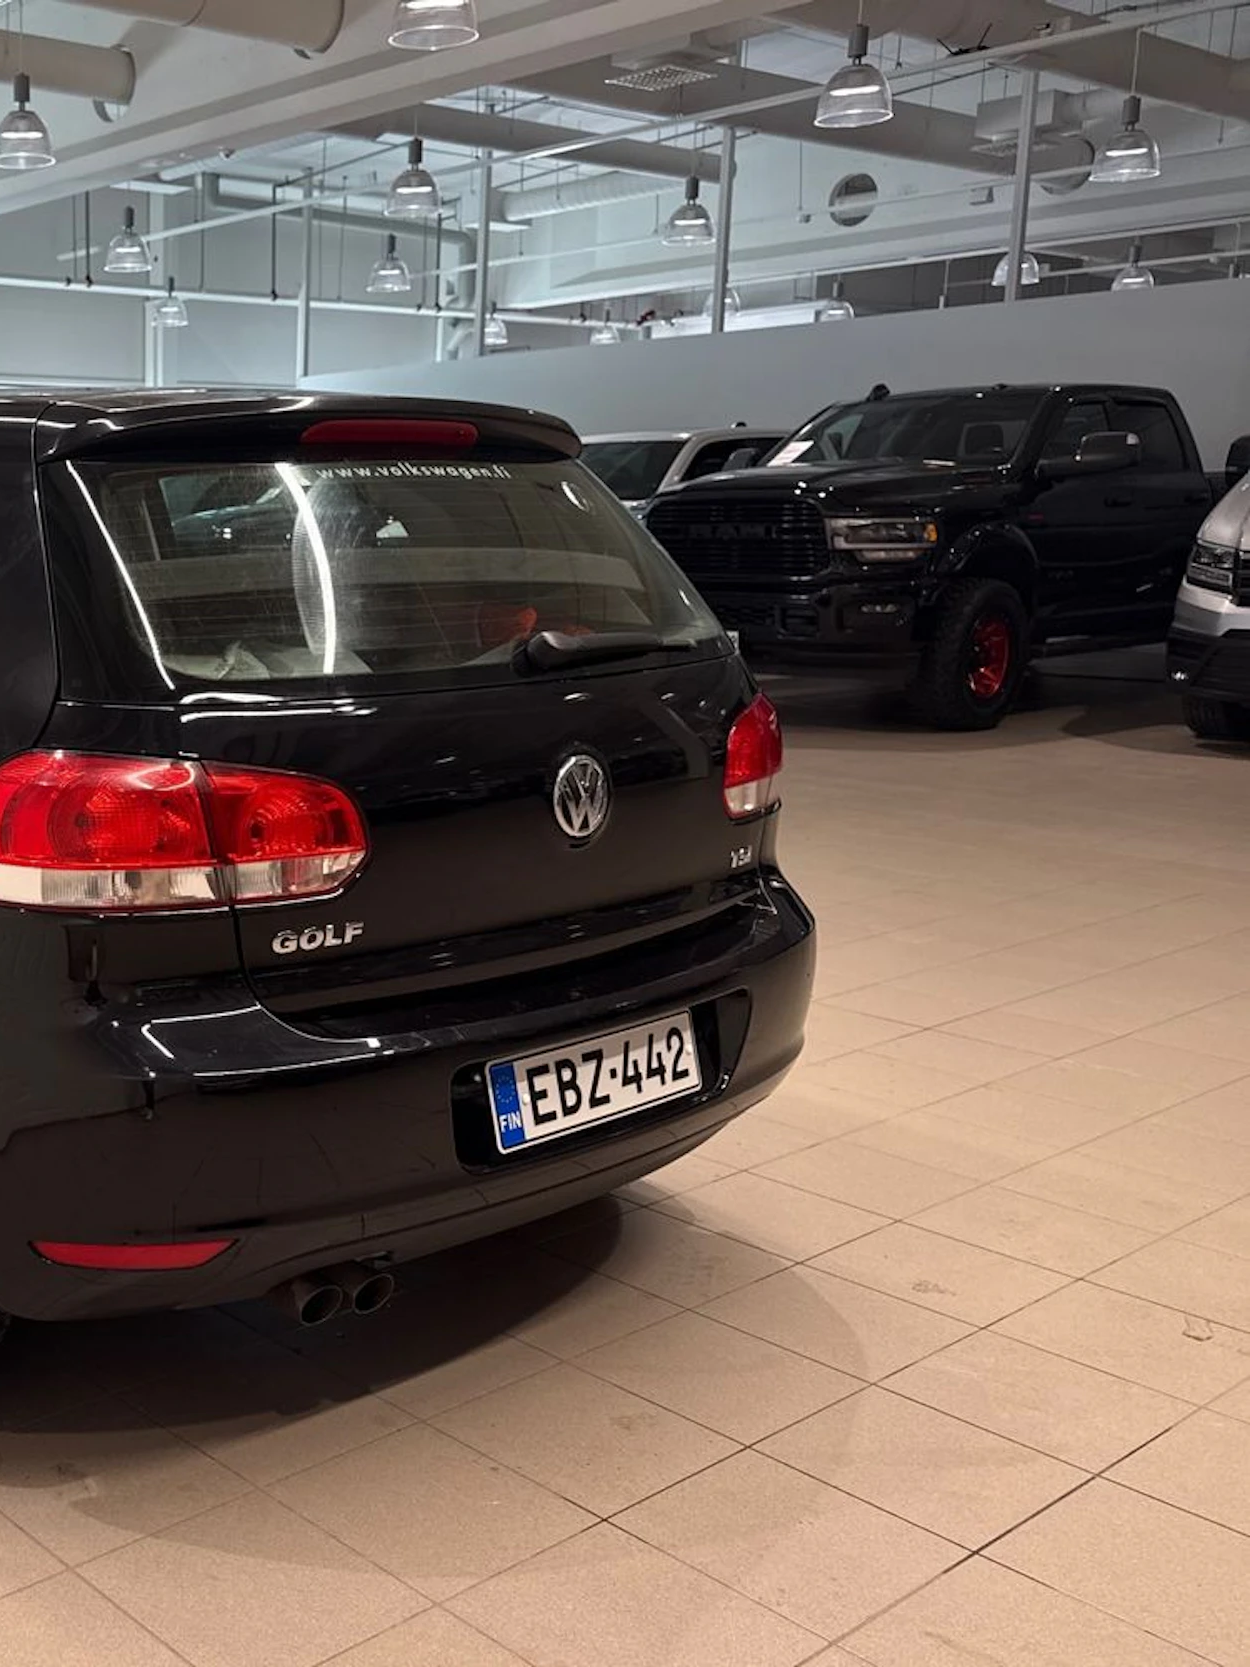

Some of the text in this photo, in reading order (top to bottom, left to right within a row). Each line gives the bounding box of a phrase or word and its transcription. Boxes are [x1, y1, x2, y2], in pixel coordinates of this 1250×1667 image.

[315, 461, 513, 480] www.volkswagen.fi
[272, 921, 365, 955] GOLF
[525, 1026, 690, 1127] EBZ-442
[499, 1110, 523, 1133] FIN
